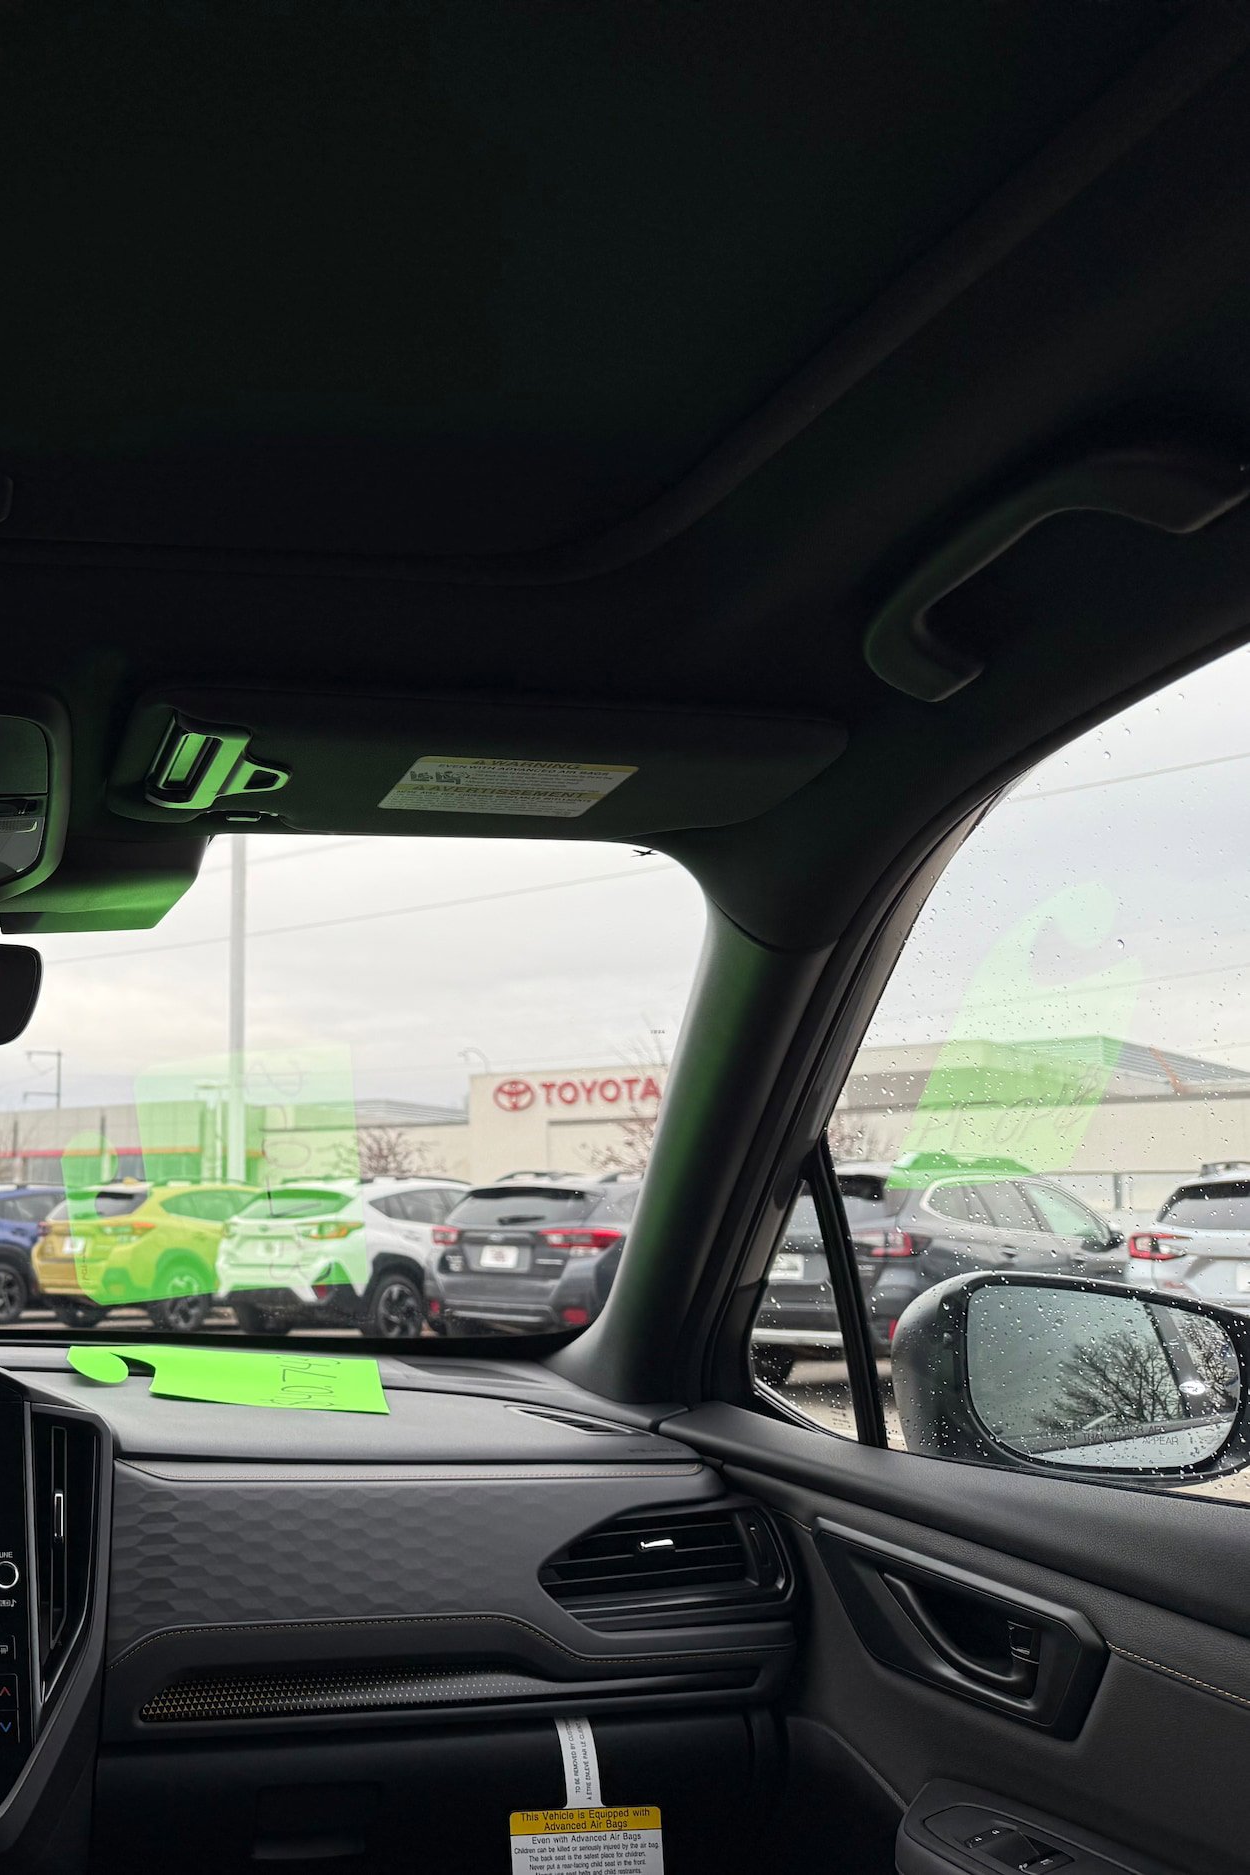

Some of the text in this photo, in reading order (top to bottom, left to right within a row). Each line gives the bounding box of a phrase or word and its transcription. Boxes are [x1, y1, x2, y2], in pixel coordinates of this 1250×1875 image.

[490, 760, 582, 770] WARNING
[427, 785, 584, 798] AVERTISSEMENT
[541, 1076, 662, 1106] TOYOTA
[1142, 1436, 1178, 1446] APPEAR
[575, 1786, 580, 1794] TO
[521, 1808, 650, 1822] This Vehicle is Equipped with
[544, 1820, 628, 1831] Advanced Air Bags
[532, 1836, 550, 1844] Even
[553, 1835, 568, 1843] with
[571, 1834, 606, 1842] Advanced
[623, 1833, 641, 1841] Bags
[580, 1844, 601, 1852] seriously
